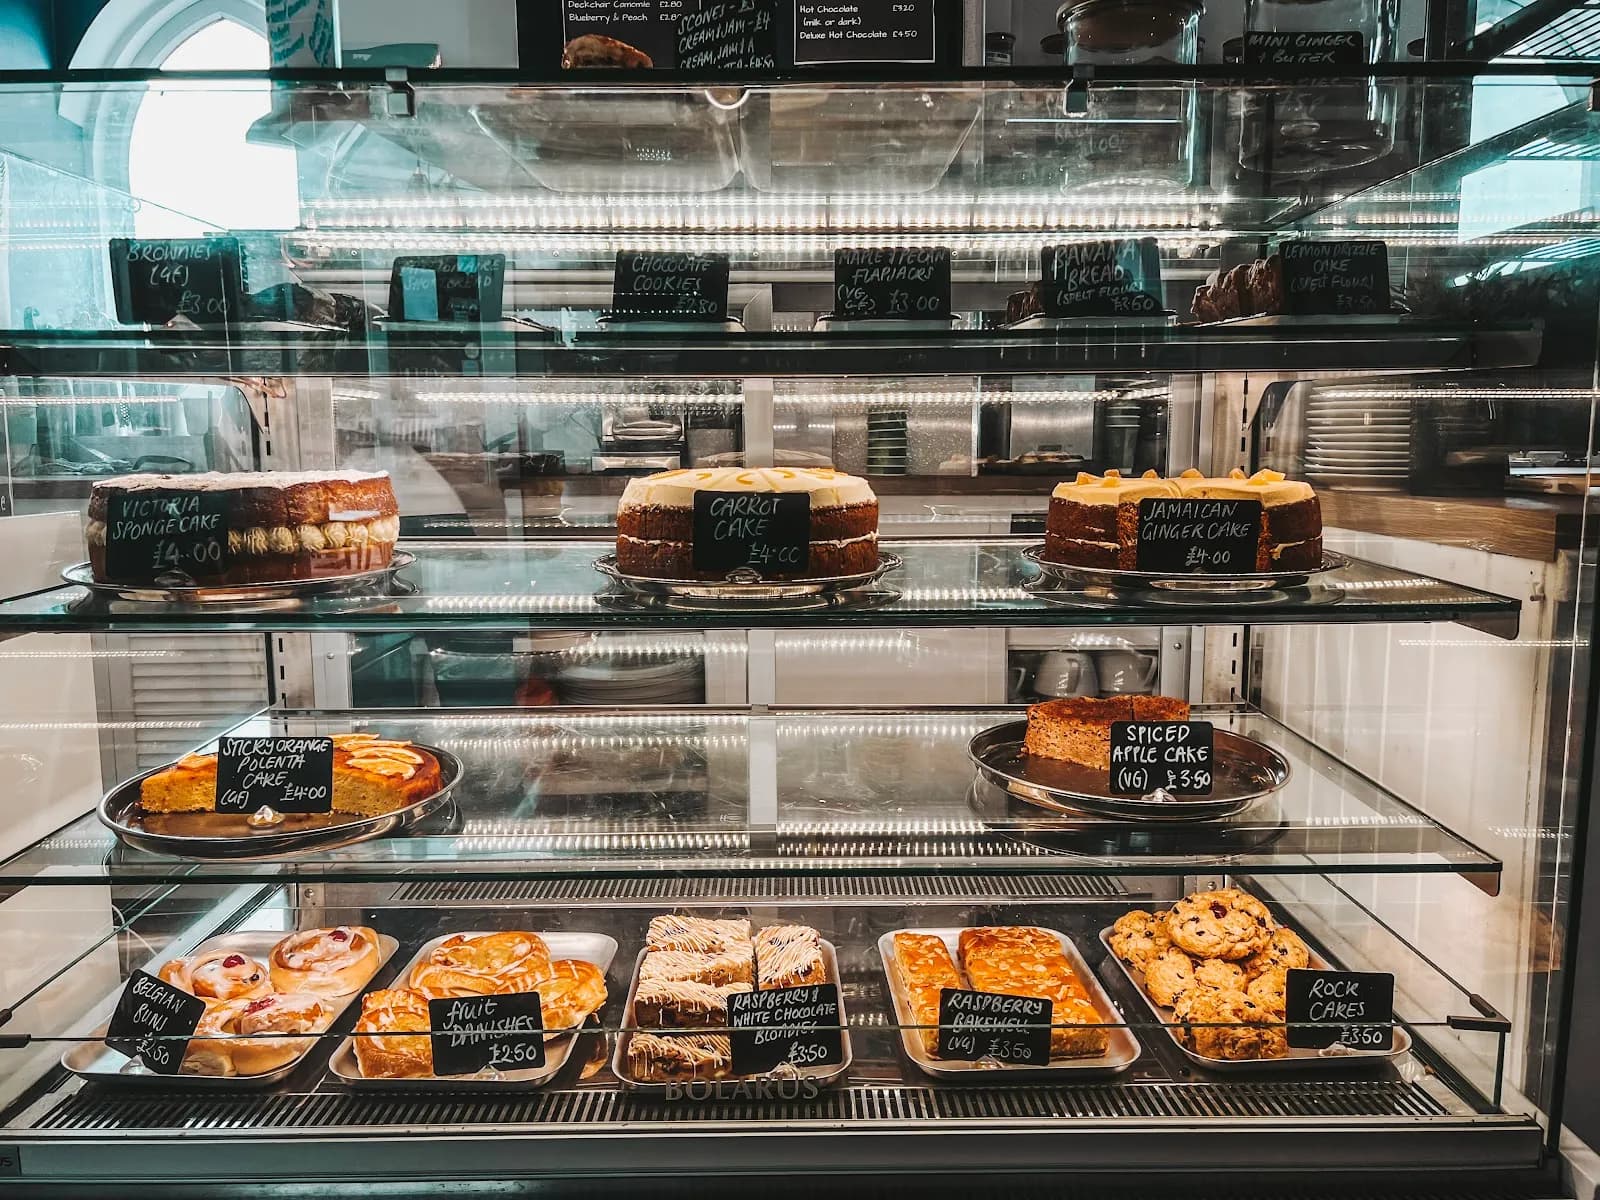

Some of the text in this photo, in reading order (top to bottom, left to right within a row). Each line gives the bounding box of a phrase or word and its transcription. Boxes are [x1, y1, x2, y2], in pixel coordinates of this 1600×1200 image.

[569, 13, 611, 24] Blueberry
[612, 12, 620, 21] &
[622, 13, 648, 21] Peach
[678, 4, 725, 35] SCONES
[800, 5, 814, 13] Hot
[817, 5, 859, 13] Chocolate
[803, 17, 822, 26] (milk
[837, 16, 862, 26] dark)
[799, 31, 826, 39] Deluxe
[829, 31, 843, 39] Hot
[846, 30, 888, 39] Chocolate
[1248, 34, 1356, 47] MINI GINGER
[126, 242, 211, 263] BROWNIES
[838, 251, 883, 265] MAPLE
[898, 250, 945, 265] PECAN
[1052, 241, 1136, 270] BANANA
[1285, 242, 1384, 259] LEMON DRIZZLE
[632, 255, 715, 272] CHOCOLATE
[1313, 258, 1353, 274] CAKE
[633, 274, 702, 291] COOKIES
[852, 265, 934, 285] FLAPJACKS
[1068, 264, 1125, 291] BREAD
[1057, 289, 1096, 306] (SPELT
[122, 496, 200, 518] VICTORIA
[709, 496, 784, 517] CARROT
[1143, 501, 1239, 521] JAMAICAN
[112, 514, 221, 540] SPONGE CAKE
[713, 517, 770, 541] CAKE
[1141, 521, 1252, 541] GINGER CAKE
[1185, 545, 1231, 567] £4.00
[1126, 724, 1190, 744] SPICED
[222, 737, 332, 757] STICKY ORANGE
[1112, 745, 1209, 764] APPLE CAKE
[237, 753, 306, 773] POLENTA
[242, 771, 289, 790] CAKE
[1118, 766, 1211, 791] (VG) £3.50
[132, 976, 187, 1014] BELGIAN
[1308, 978, 1360, 999] ROCK
[732, 988, 809, 1013] RASPBERRY
[947, 992, 1043, 1015] RASPBERRY
[1309, 1000, 1366, 1021] CAKES
[133, 1003, 169, 1032] BUNS
[733, 1003, 837, 1028] WHITE CHOCOLATE
[952, 1011, 1030, 1034] BAKEWELL
[450, 1015, 534, 1048] DANISHES
[754, 1020, 818, 1045] BLONDIES
[1335, 1026, 1384, 1045] £3.50
[488, 1043, 537, 1065] £2.50
[788, 1041, 828, 1064] £3.50
[664, 1075, 819, 1101] BOLARUS
